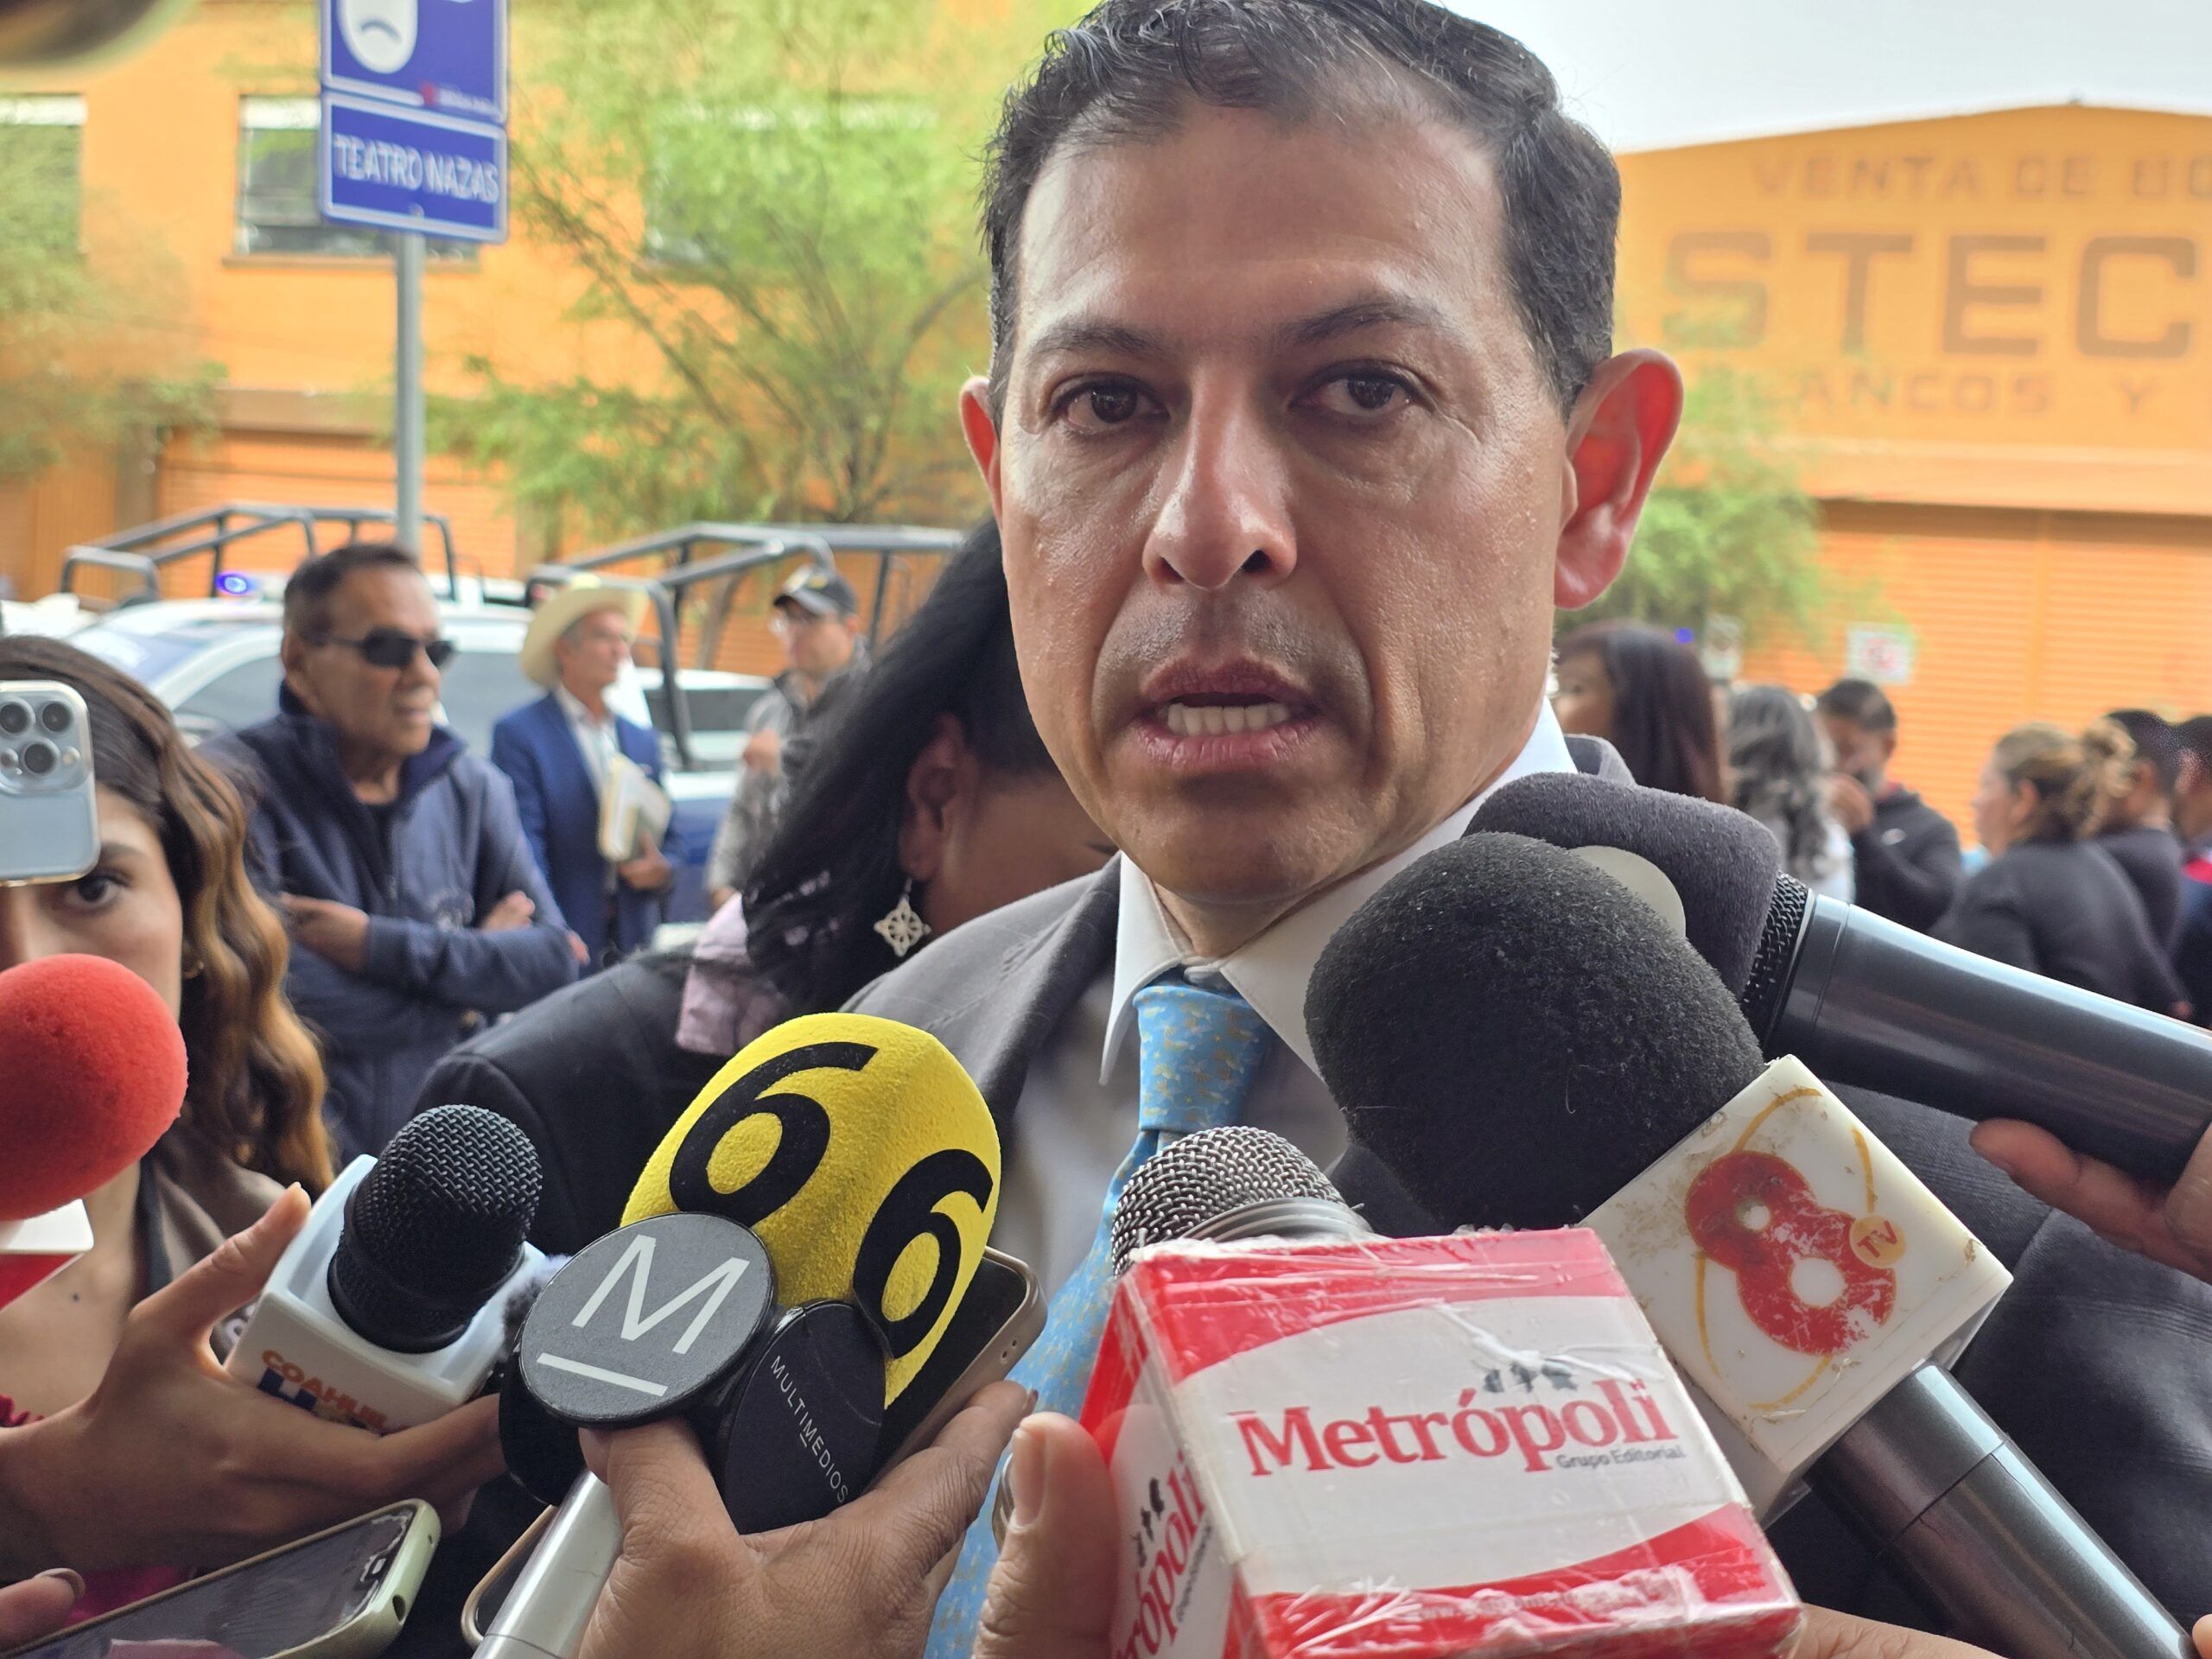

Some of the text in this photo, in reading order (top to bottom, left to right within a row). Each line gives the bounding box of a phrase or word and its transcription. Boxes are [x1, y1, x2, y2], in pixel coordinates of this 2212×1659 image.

[333, 132, 499, 204] TEATRO NAZAS
[1752, 156, 1982, 195] VENTA
[2014, 156, 2094, 196] DE
[669, 1041, 880, 1229] 6
[571, 1235, 750, 1354] M
[854, 1148, 994, 1360] 6
[1685, 1150, 1897, 1356] 8
[1857, 1219, 1899, 1259] TV
[771, 1355, 849, 1503] MULTIMEDIOS
[1227, 1378, 1679, 1476] Metrópoli
[1556, 1444, 1686, 1470] Grupo Editorial
[1116, 1449, 1205, 1659] rópoli
